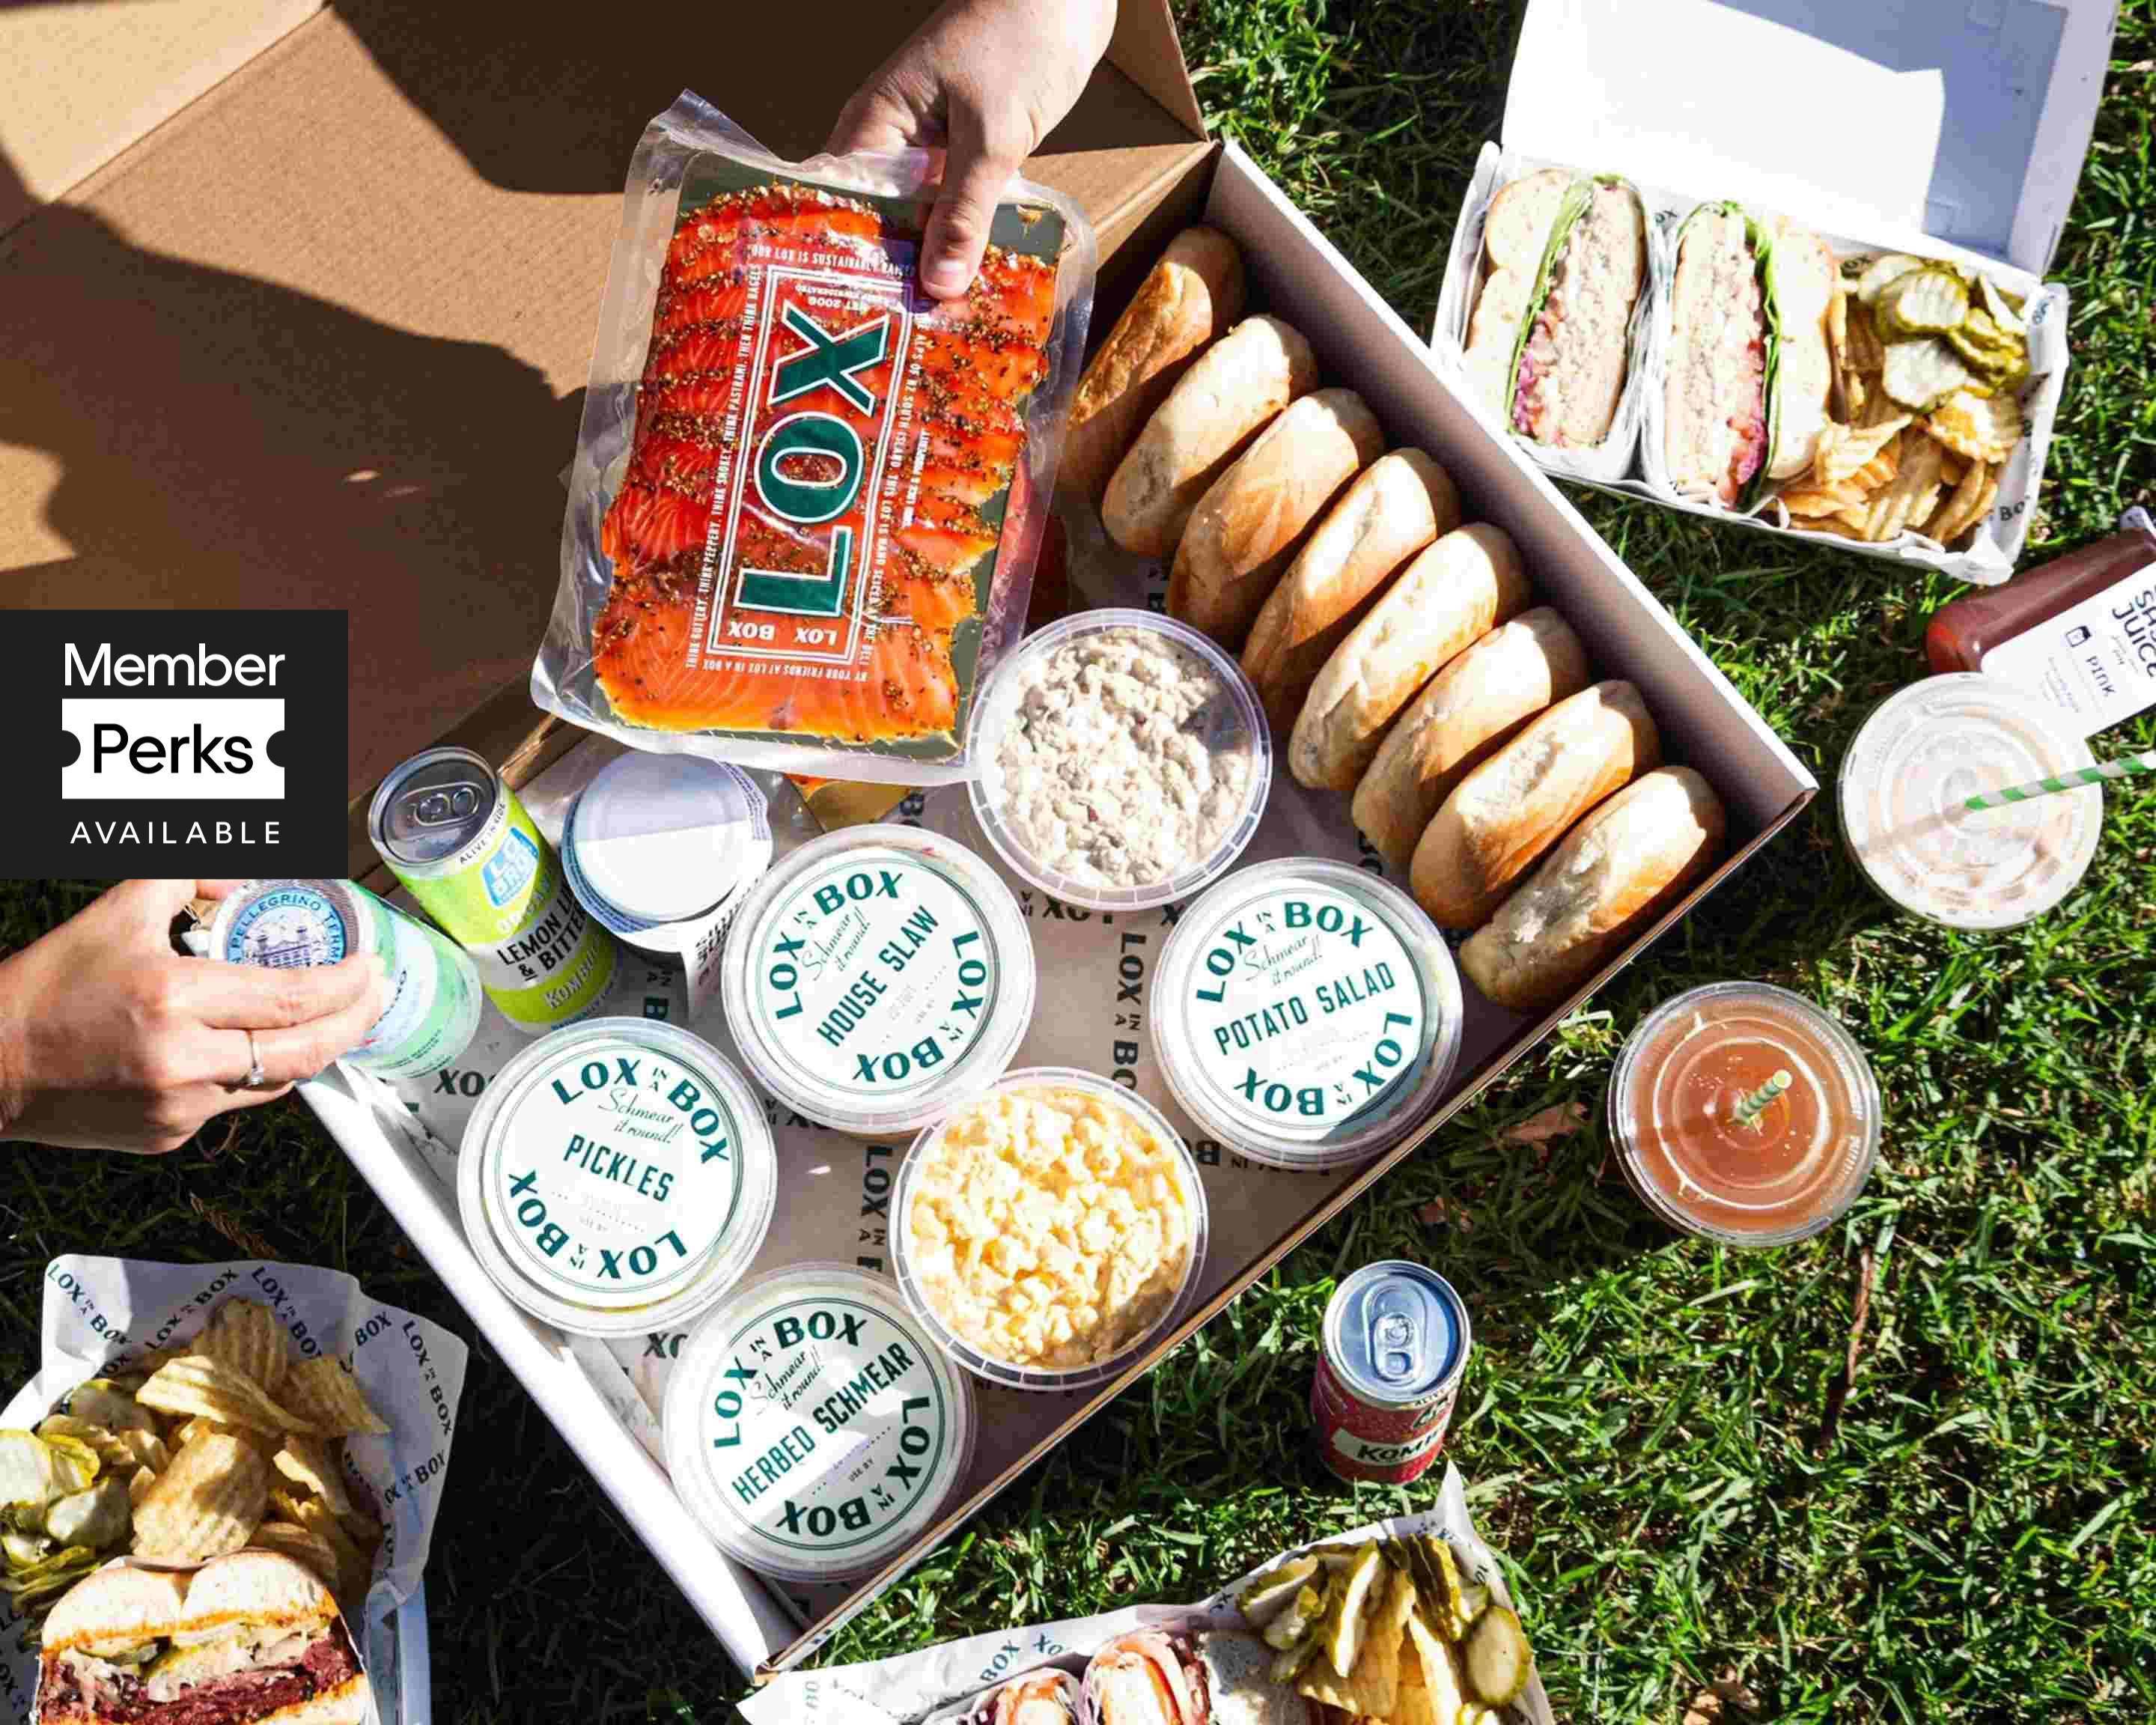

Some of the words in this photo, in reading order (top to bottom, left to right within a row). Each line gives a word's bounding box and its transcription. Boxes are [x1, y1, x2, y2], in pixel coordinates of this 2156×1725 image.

[797, 249, 808, 264] IS
[913, 335, 927, 360] ALPS
[899, 394, 914, 430] SOUTH
[733, 299, 891, 618] LOX
[685, 642, 701, 669] THINK
[698, 565, 713, 593] THINK
[711, 487, 726, 516] THINK
[723, 412, 737, 442] THINK
[743, 302, 757, 331] THINK
[728, 621, 776, 641] BOX
[794, 627, 838, 646] LOX
[231, 894, 321, 949] PELLEGRINO
[497, 912, 561, 966] LEMON
[769, 931, 806, 1020] LOX
[813, 870, 903, 916] BOX
[518, 964, 538, 981] &
[816, 970, 888, 1047] HOUSE
[878, 904, 939, 973] SLAW
[951, 931, 987, 1020] LOX
[1116, 932, 1147, 1007] LOX
[1196, 921, 1258, 1003] LOX
[1284, 901, 1374, 948] BOX
[1114, 1013, 1126, 1026] A
[1130, 1011, 1141, 1031] IN
[1213, 996, 1309, 1056] POTATO
[1315, 961, 1395, 1014] SALAD
[853, 1036, 945, 1083] BOX
[1109, 1039, 1139, 1090] BO
[1352, 1011, 1413, 1096] LOX
[551, 1058, 641, 1105] LOX
[667, 1079, 729, 1164] BOX
[597, 1086, 674, 1124] Schmear
[1234, 1067, 1324, 1116] BOX
[563, 1134, 674, 1202] PICKLES
[862, 1146, 893, 1220] LOX
[508, 1169, 570, 1258] BOX
[859, 1228, 871, 1242] A
[873, 1228, 886, 1246] IN
[597, 1229, 688, 1280] LOX
[48, 1264, 85, 1303] LOX
[90, 1314, 133, 1345] BOX
[144, 1314, 182, 1351] LOX
[195, 1266, 240, 1305] BOX
[251, 1265, 288, 1309] LOX
[354, 1312, 392, 1347] BOX
[402, 1320, 430, 1367] LOX
[430, 1384, 452, 1435] BOX
[713, 1355, 758, 1448] LOX
[749, 1336, 767, 1353] IN
[761, 1350, 773, 1362] A
[773, 1311, 867, 1349] BOX
[731, 1425, 816, 1505] HERBED
[812, 1342, 915, 1435] SCHMEAR
[885, 1396, 931, 1491] LOX
[871, 1483, 883, 1497] A
[877, 1493, 896, 1511] IN
[776, 1496, 871, 1537] BOX
[980, 1638, 1020, 1682] BOX
